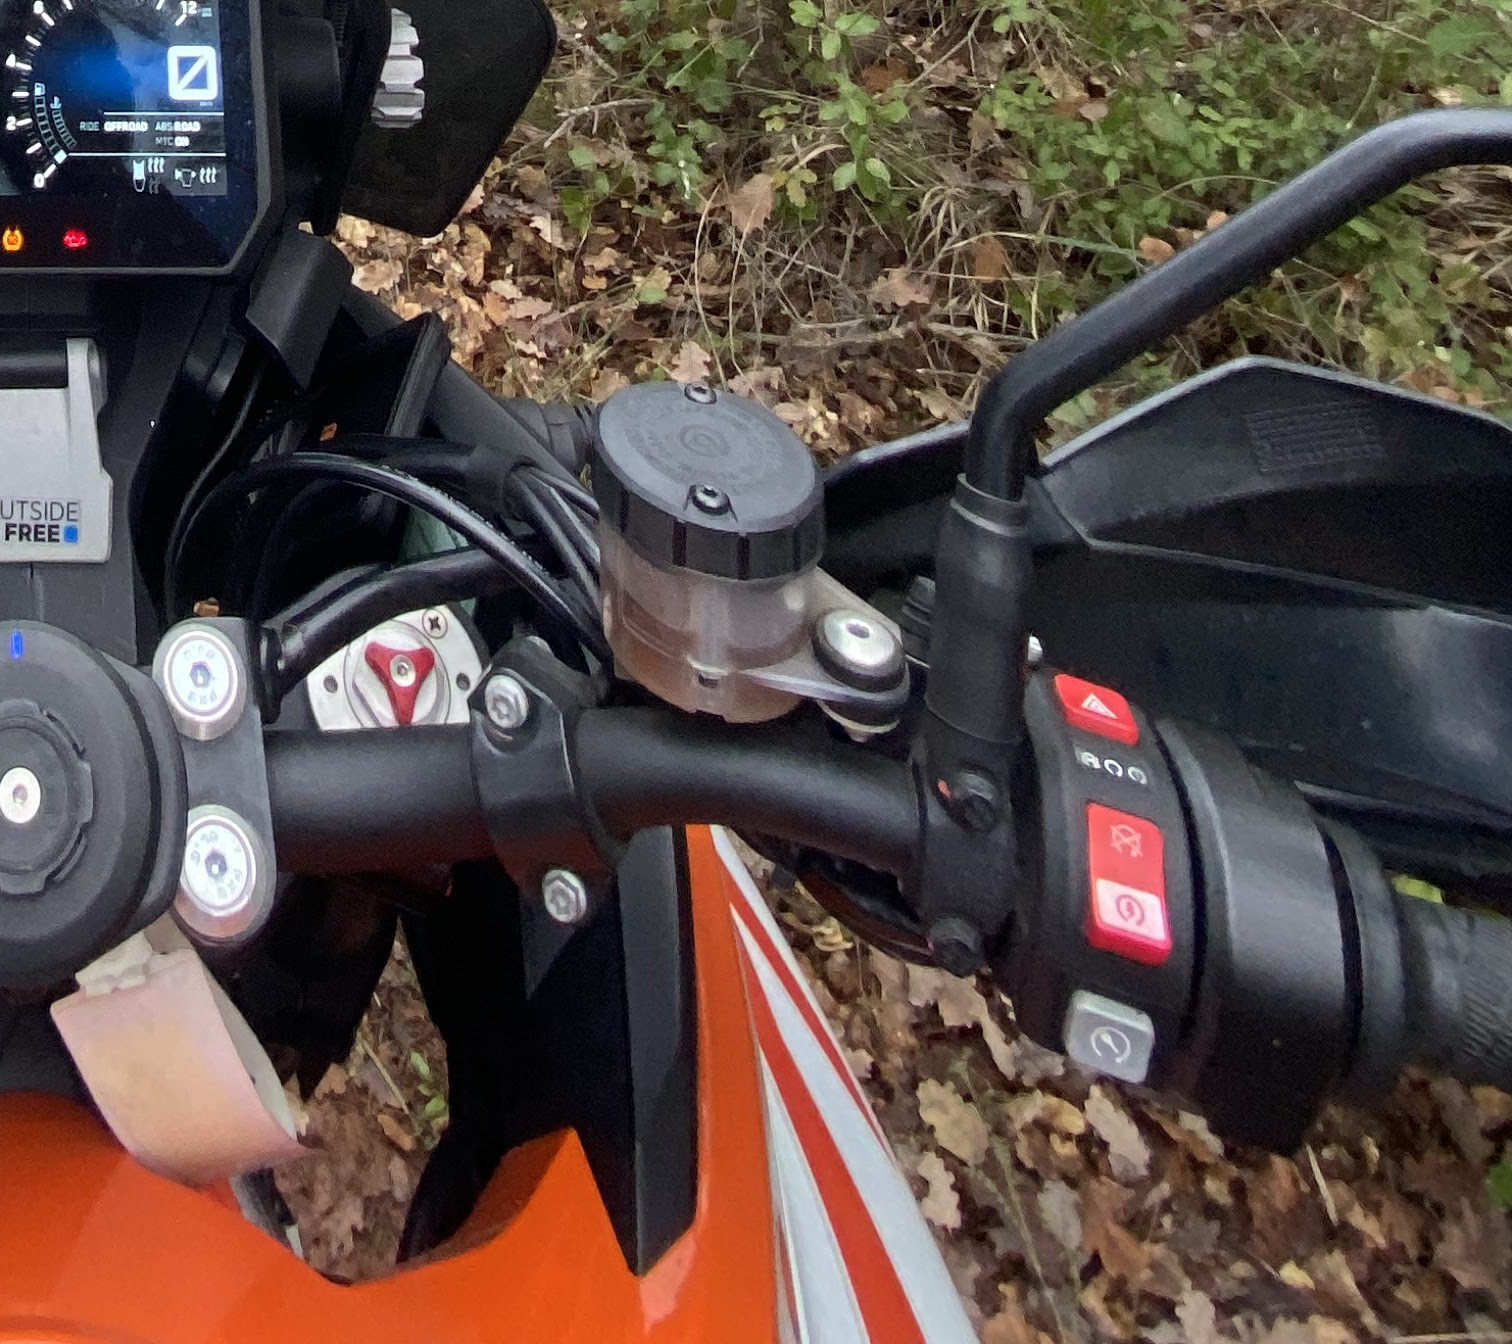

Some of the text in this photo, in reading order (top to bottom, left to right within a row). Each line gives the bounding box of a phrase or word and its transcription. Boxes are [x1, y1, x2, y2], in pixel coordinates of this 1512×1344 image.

[33, 0, 44, 14] 6
[180, 1, 197, 15] 12
[5, 53, 16, 67] 4
[6, 116, 17, 131] 2
[79, 121, 148, 132] RIDE OFFROAD
[155, 121, 201, 132] ABS ROAD
[155, 136, 190, 147] MTC ON
[33, 173, 44, 188] 0
[4, 523, 61, 543] FREE
